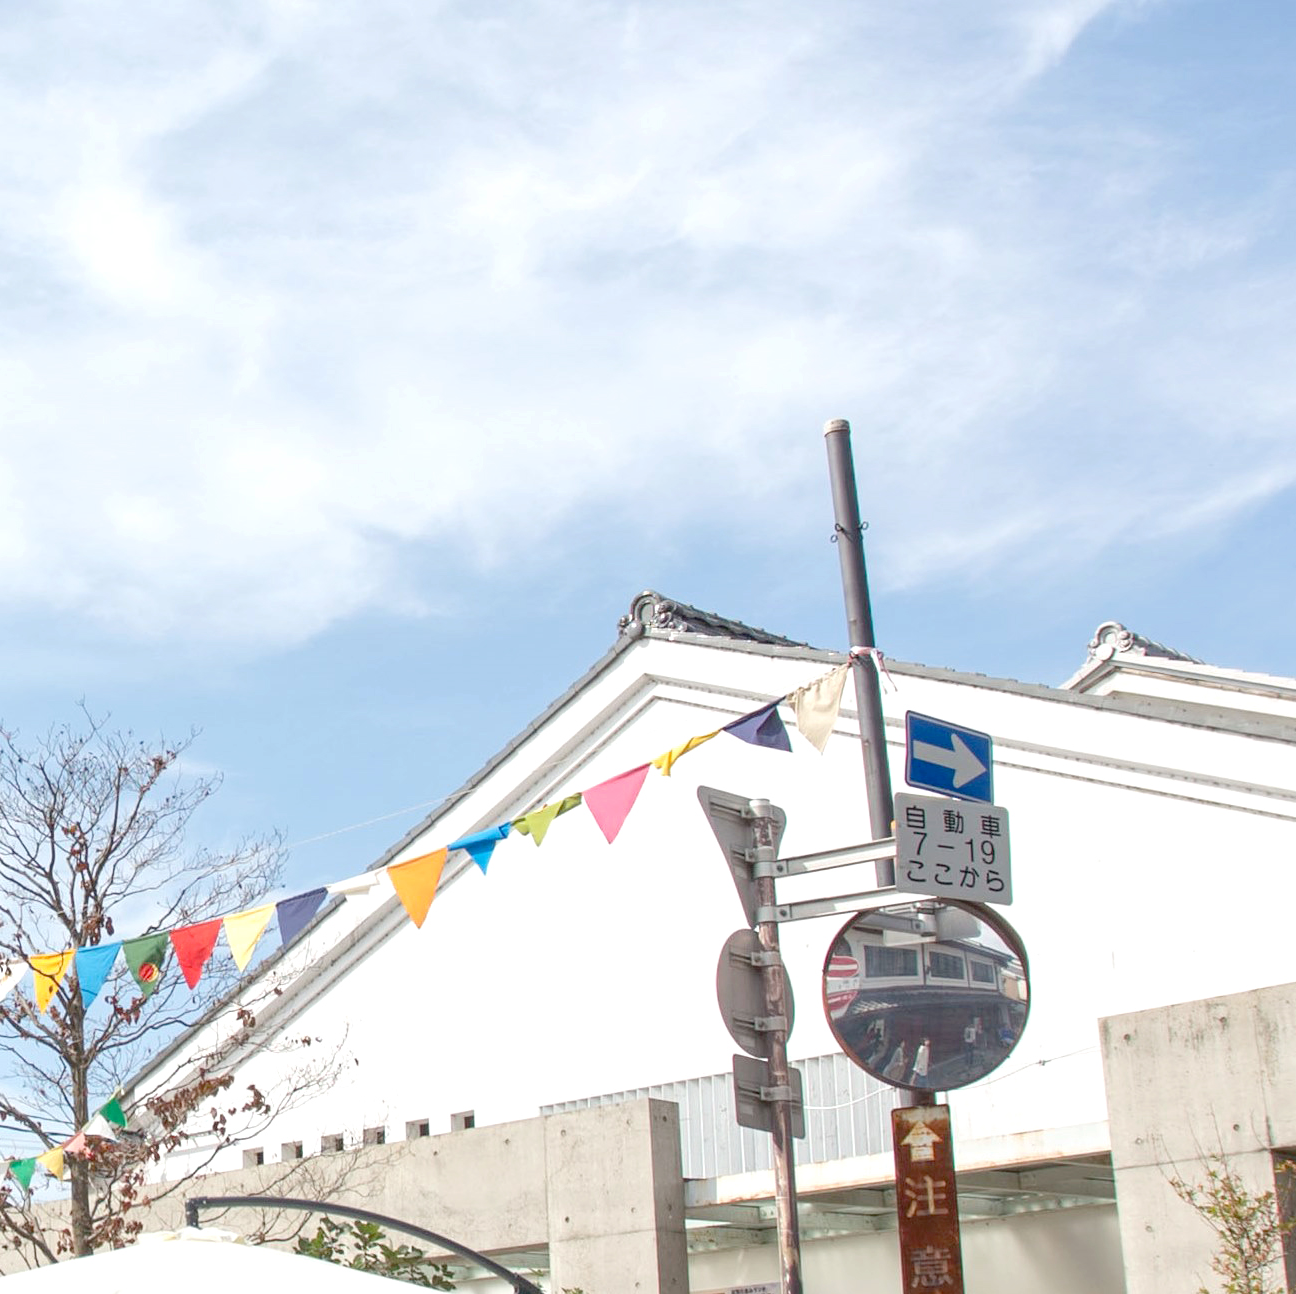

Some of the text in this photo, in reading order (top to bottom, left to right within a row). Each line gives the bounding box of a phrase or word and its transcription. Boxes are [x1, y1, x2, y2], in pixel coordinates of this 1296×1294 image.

[906, 804, 1002, 839] 自動車
[907, 858, 1006, 893] ここから
[904, 1174, 954, 1289] 注意
